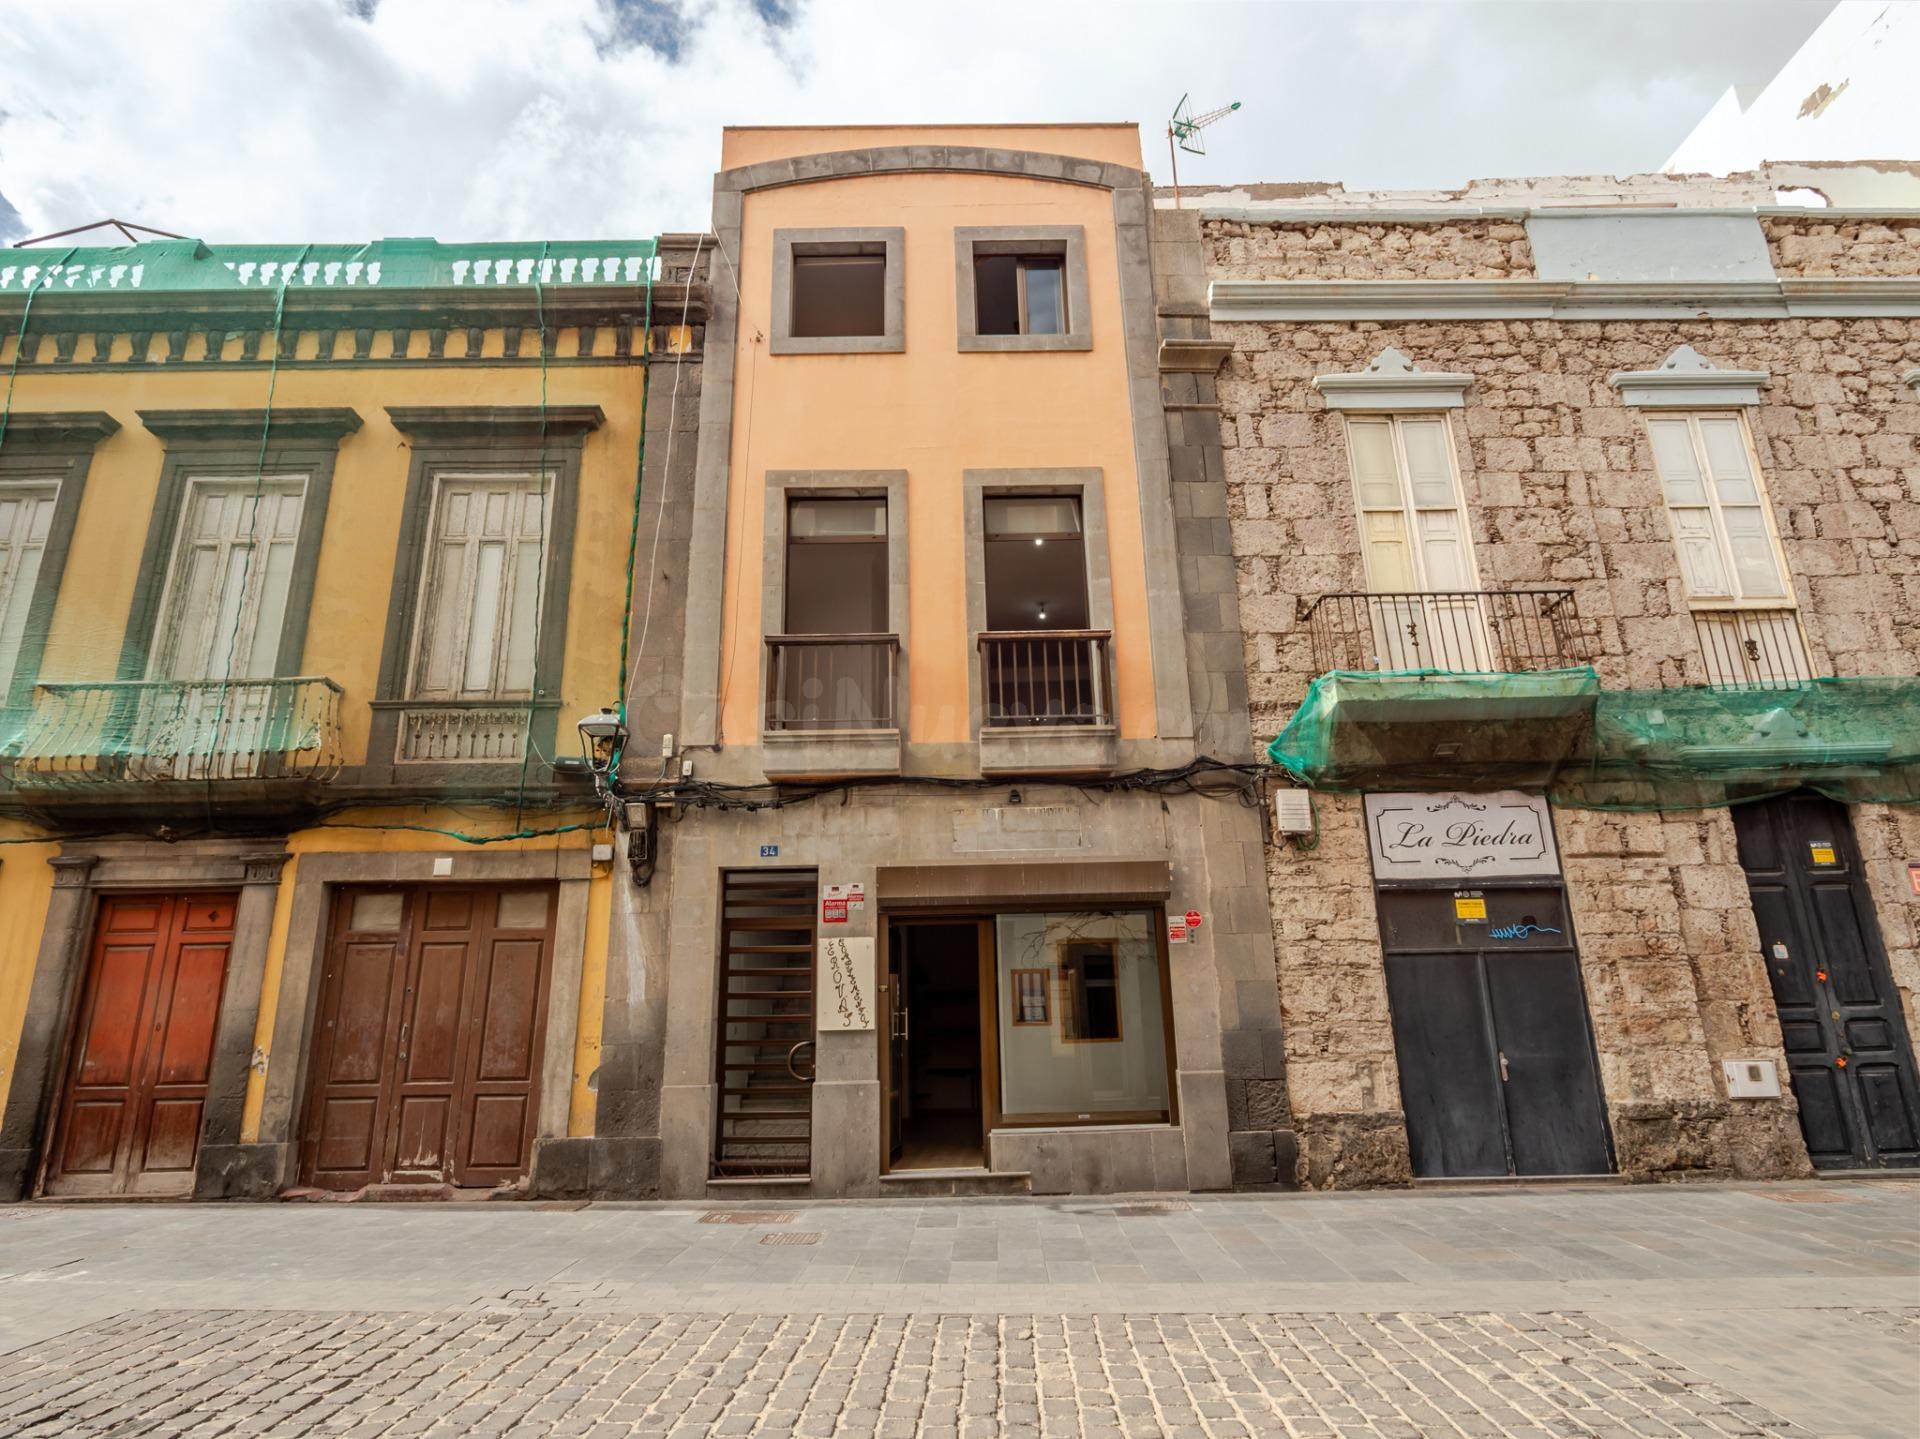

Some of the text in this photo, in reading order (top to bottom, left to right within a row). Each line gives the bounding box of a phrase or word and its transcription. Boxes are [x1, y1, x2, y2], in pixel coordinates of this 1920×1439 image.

[1388, 819, 1534, 849] La Piedra
[762, 846, 776, 856] 34
